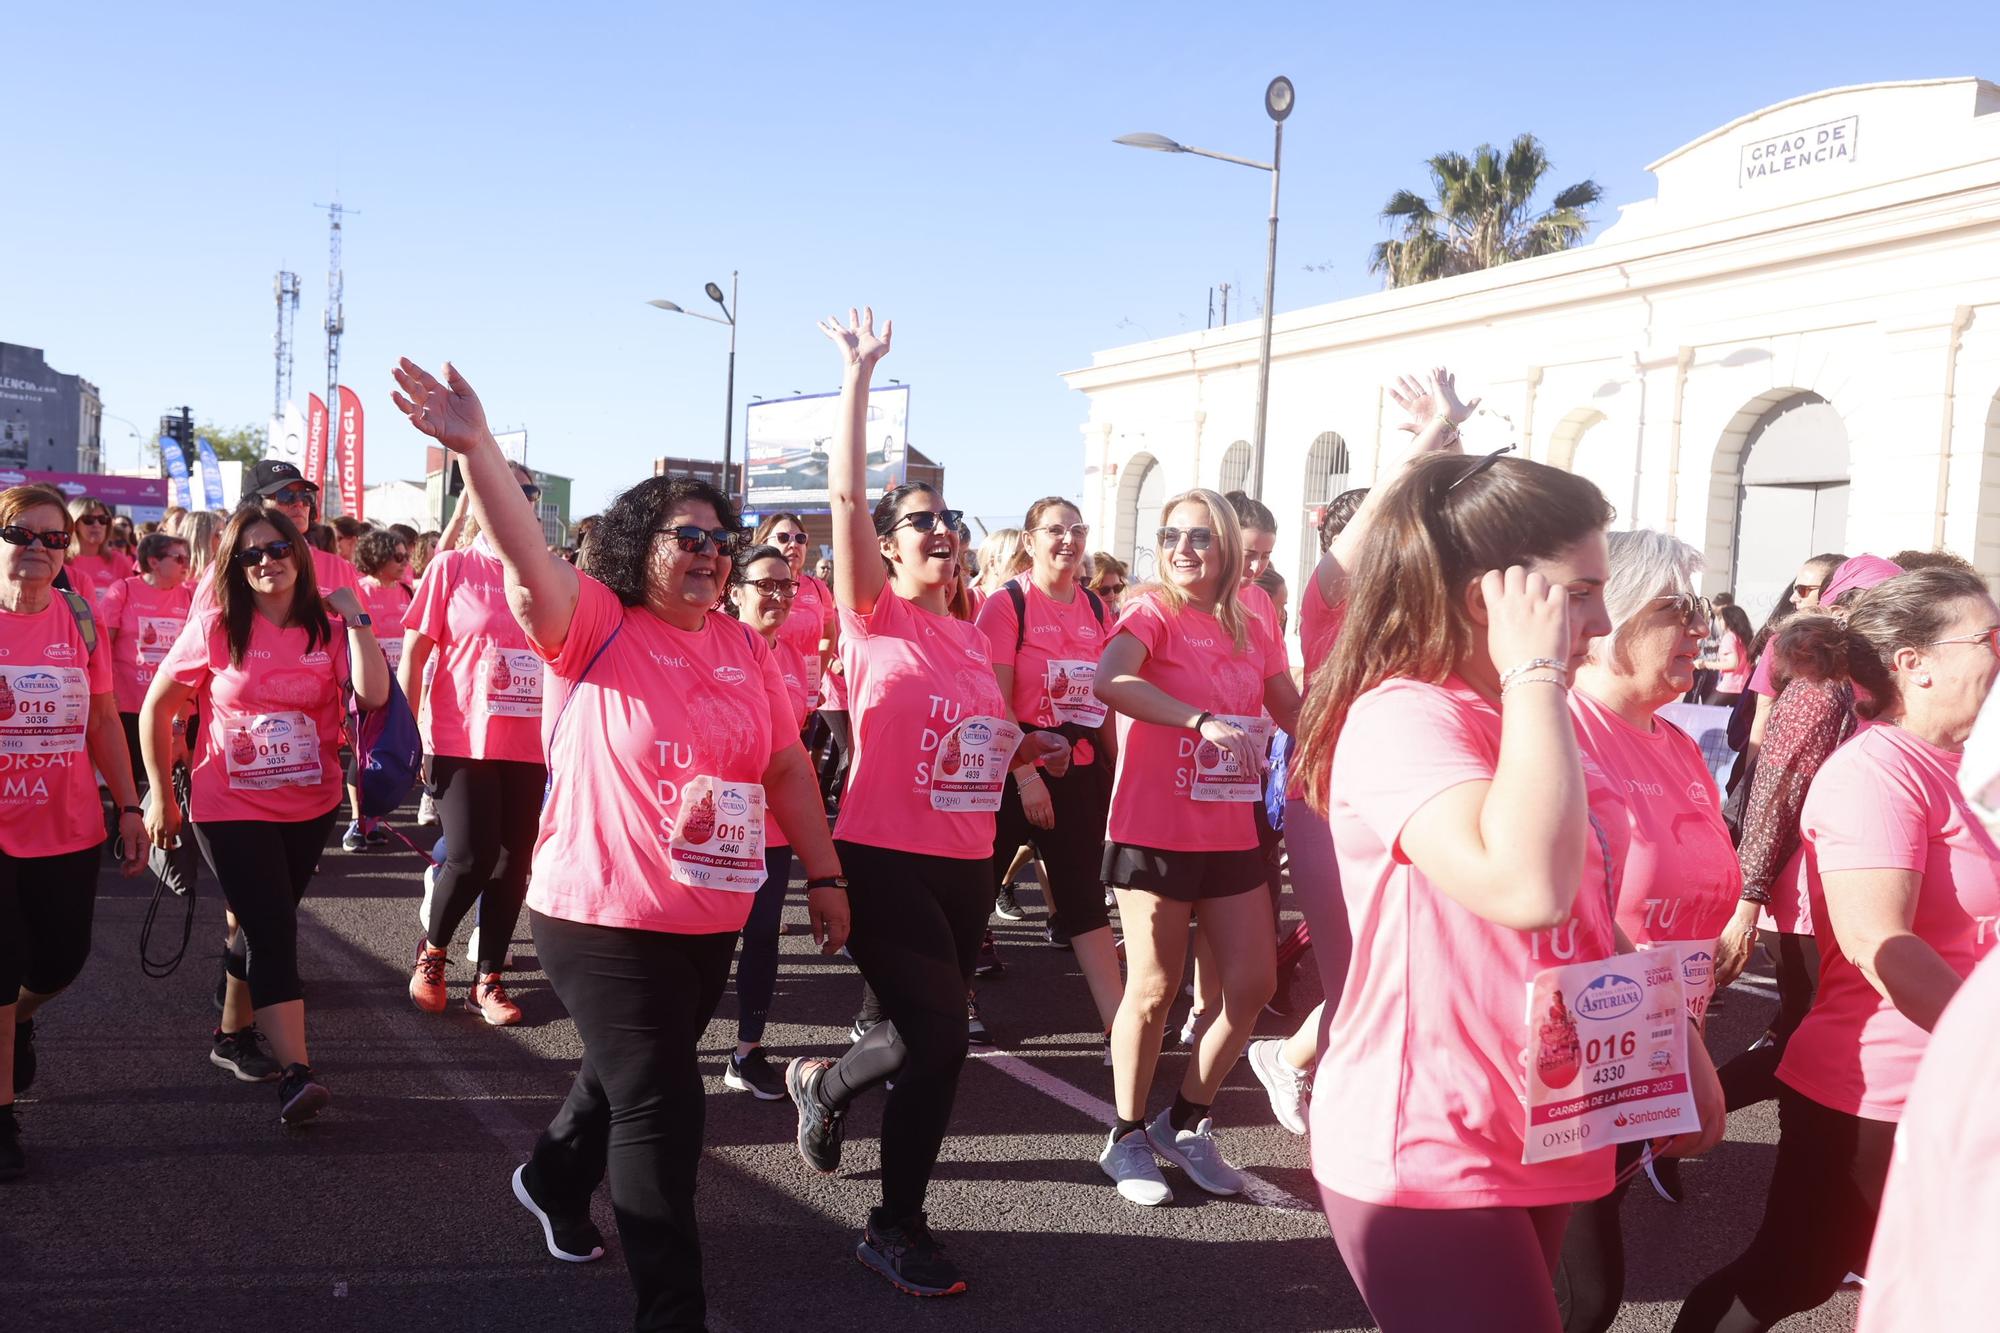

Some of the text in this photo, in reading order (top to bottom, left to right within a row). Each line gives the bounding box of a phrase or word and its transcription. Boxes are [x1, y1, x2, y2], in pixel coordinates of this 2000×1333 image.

[1752, 125, 1846, 161] GRAO DE
[1747, 143, 1848, 179] VALENCIA
[1033, 624, 1061, 633] OYSHO
[18, 680, 59, 689] ASTURIANA
[513, 675, 537, 687] 016
[1068, 685, 1089, 695] 016
[19, 700, 56, 713] 016
[929, 694, 961, 723] TU
[25, 716, 49, 724] 3036
[259, 742, 290, 756] 016
[655, 740, 694, 769] TU
[266, 756, 286, 765] 3035
[962, 753, 984, 767] 016
[965, 770, 980, 779] 4939
[934, 796, 960, 805] OYSHO
[717, 823, 745, 841] 016
[720, 843, 739, 854] 4940
[682, 852, 714, 865] CARRERA
[680, 866, 711, 880] OYSHO
[1644, 898, 1681, 929] TU
[1647, 972, 1674, 987] SUMA
[1582, 991, 1640, 1012] ASTURIANA
[1586, 1031, 1636, 1064] 016
[1592, 1064, 1625, 1084] 4330
[1547, 1080, 1674, 1118] CARRERA DE LA MUJER 2023
[1542, 1106, 1681, 1148] OYSHO Santander
